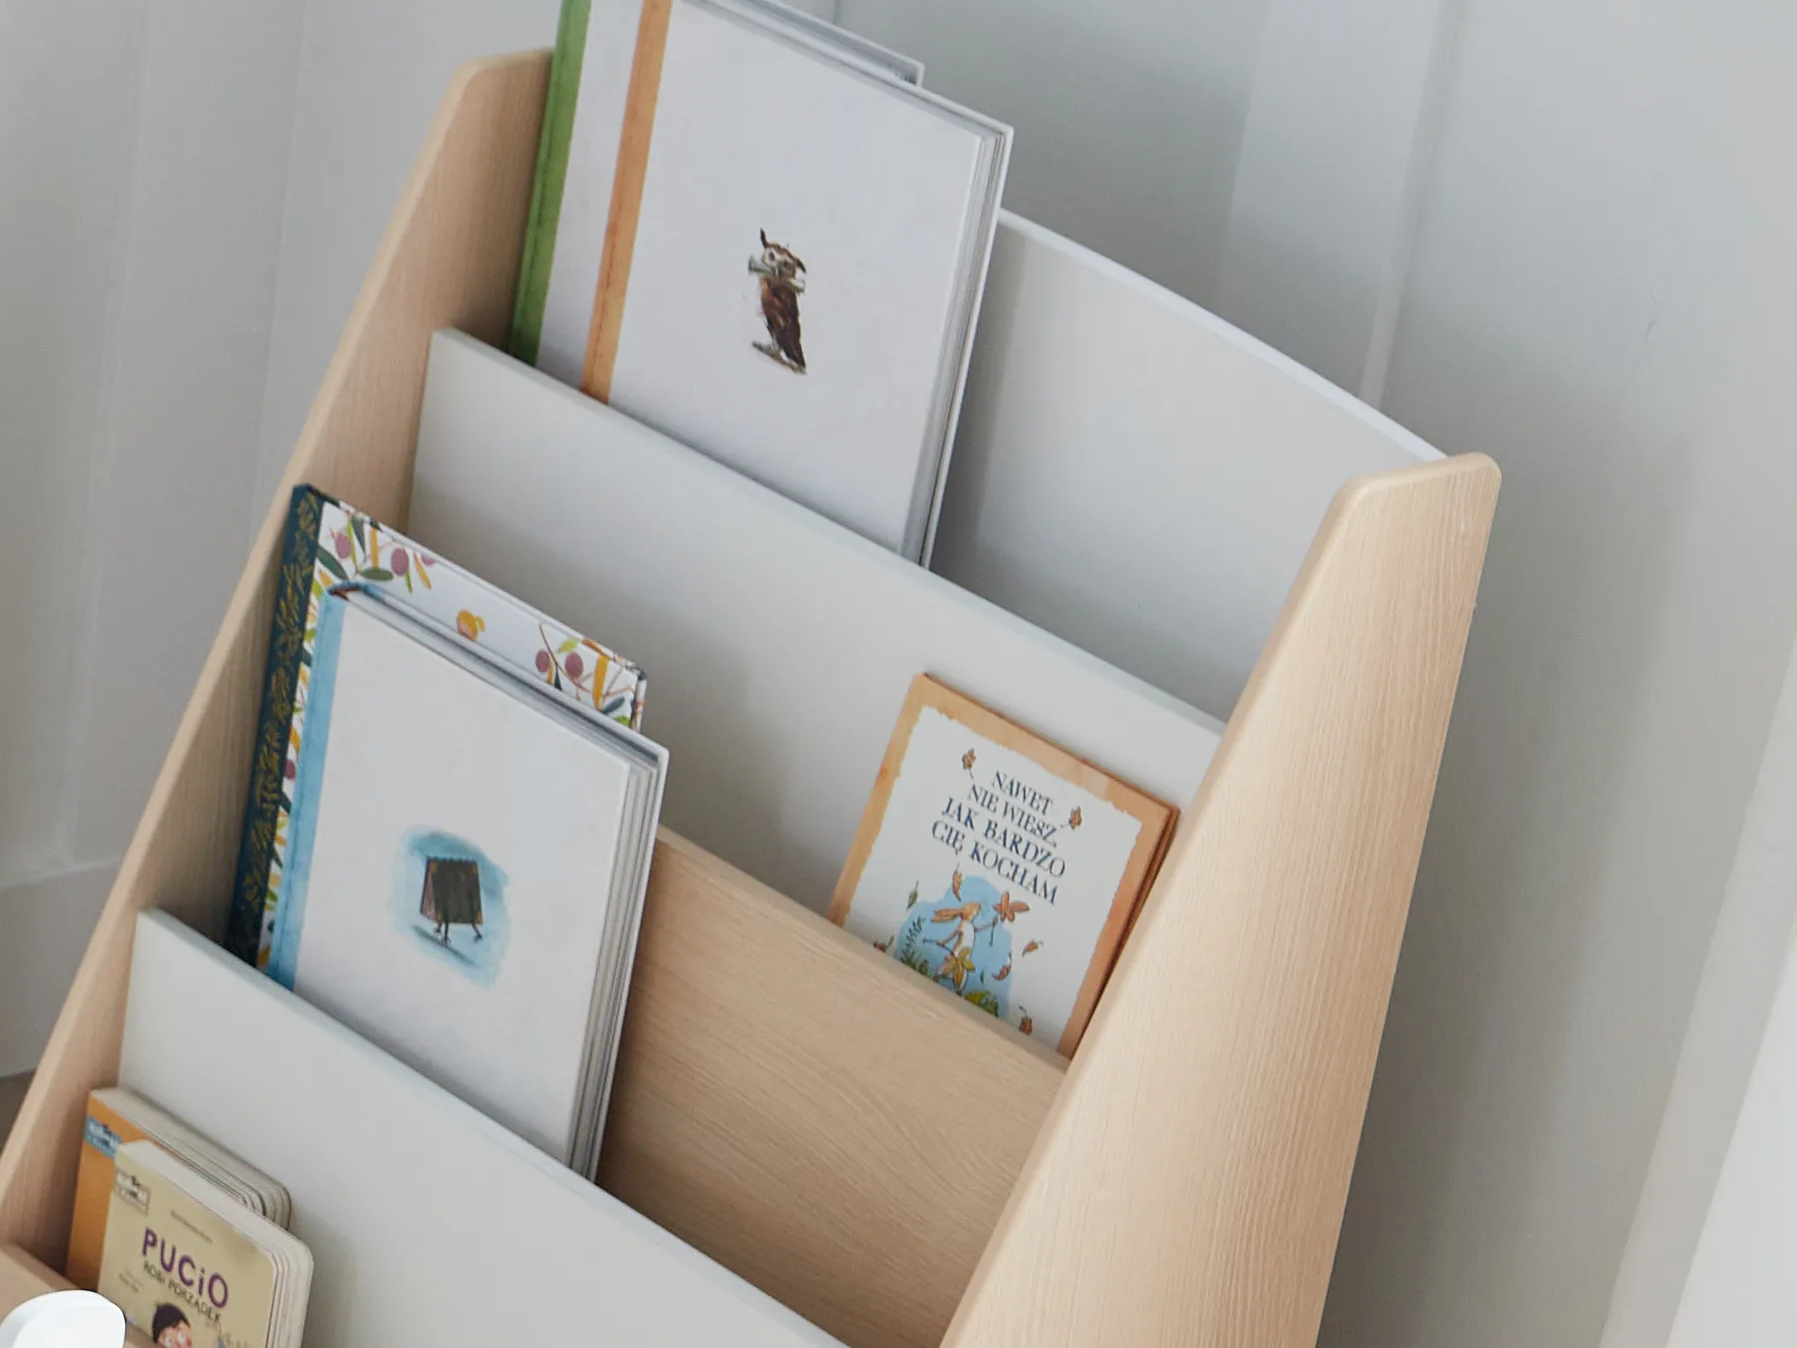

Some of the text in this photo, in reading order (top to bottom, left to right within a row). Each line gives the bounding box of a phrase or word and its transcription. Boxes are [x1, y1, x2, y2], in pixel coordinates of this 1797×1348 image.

[968, 783, 999, 813] NIE
[992, 770, 1053, 815] NAWET
[932, 820, 1058, 904] CIĘ KOCHAM
[941, 796, 1065, 878] JAK BARDZO
